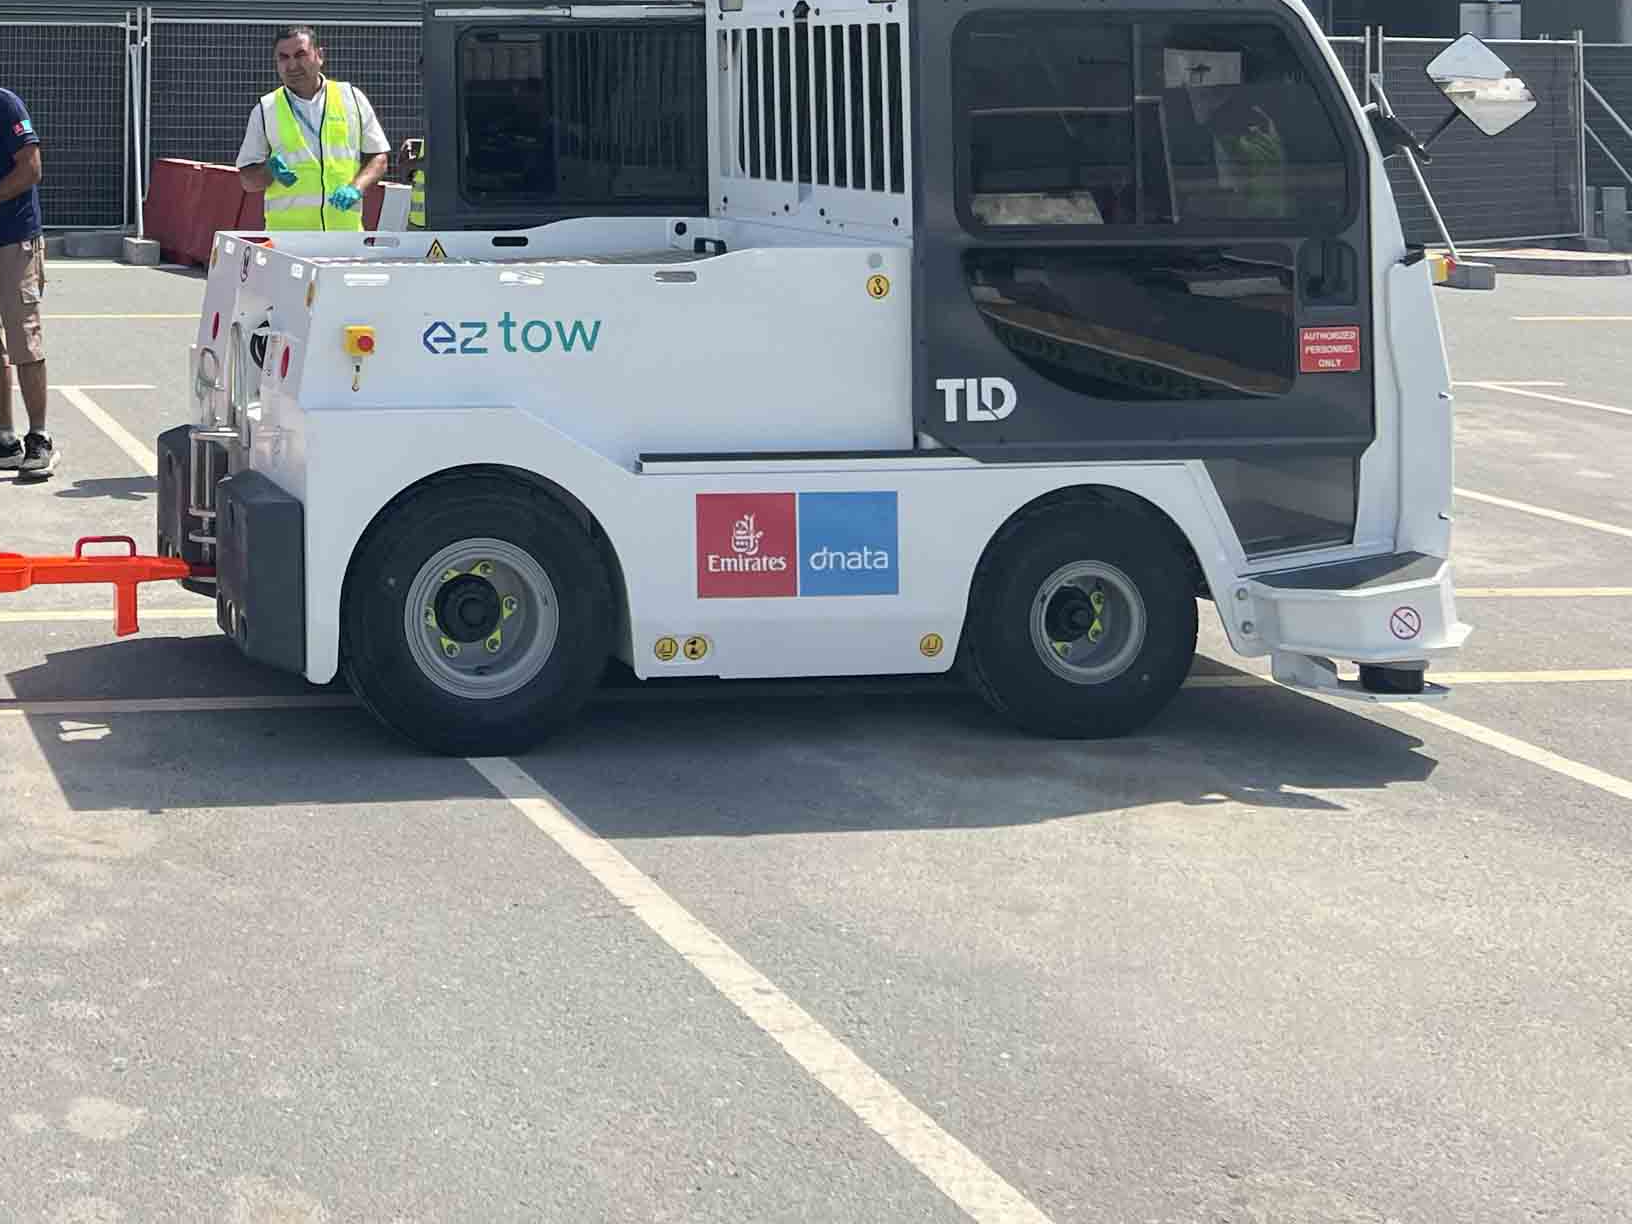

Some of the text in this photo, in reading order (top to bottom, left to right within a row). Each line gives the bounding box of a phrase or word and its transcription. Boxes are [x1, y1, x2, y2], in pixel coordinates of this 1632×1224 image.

[497, 312, 602, 353] tow
[1305, 344, 1355, 354] PERSONNEL
[1319, 359, 1344, 368] ONLY
[936, 377, 1017, 422] TLD
[707, 554, 787, 572] Emirates
[809, 546, 889, 570] dnata
